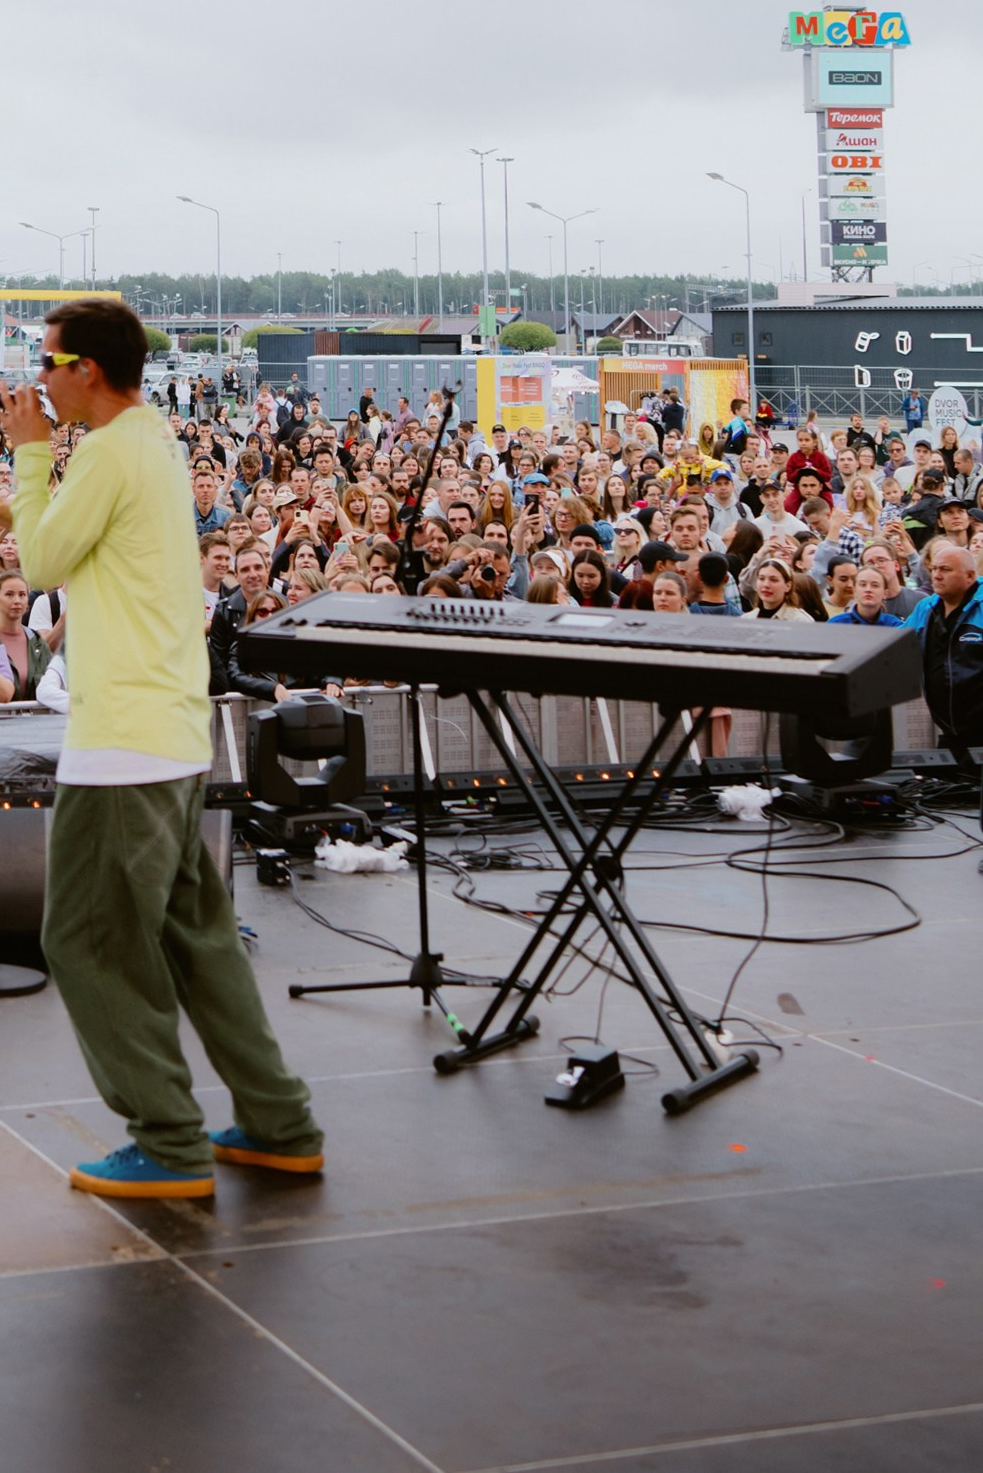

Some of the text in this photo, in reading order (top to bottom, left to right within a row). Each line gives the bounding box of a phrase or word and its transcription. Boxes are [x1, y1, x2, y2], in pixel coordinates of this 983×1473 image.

[829, 111, 882, 125] Теремок
[831, 155, 883, 169] OBI
[843, 225, 876, 235] КИНО
[622, 360, 668, 371] MEGA merch
[935, 399, 959, 408] DVOR
[935, 408, 962, 418] MUSIC
[936, 418, 956, 427] FEST
